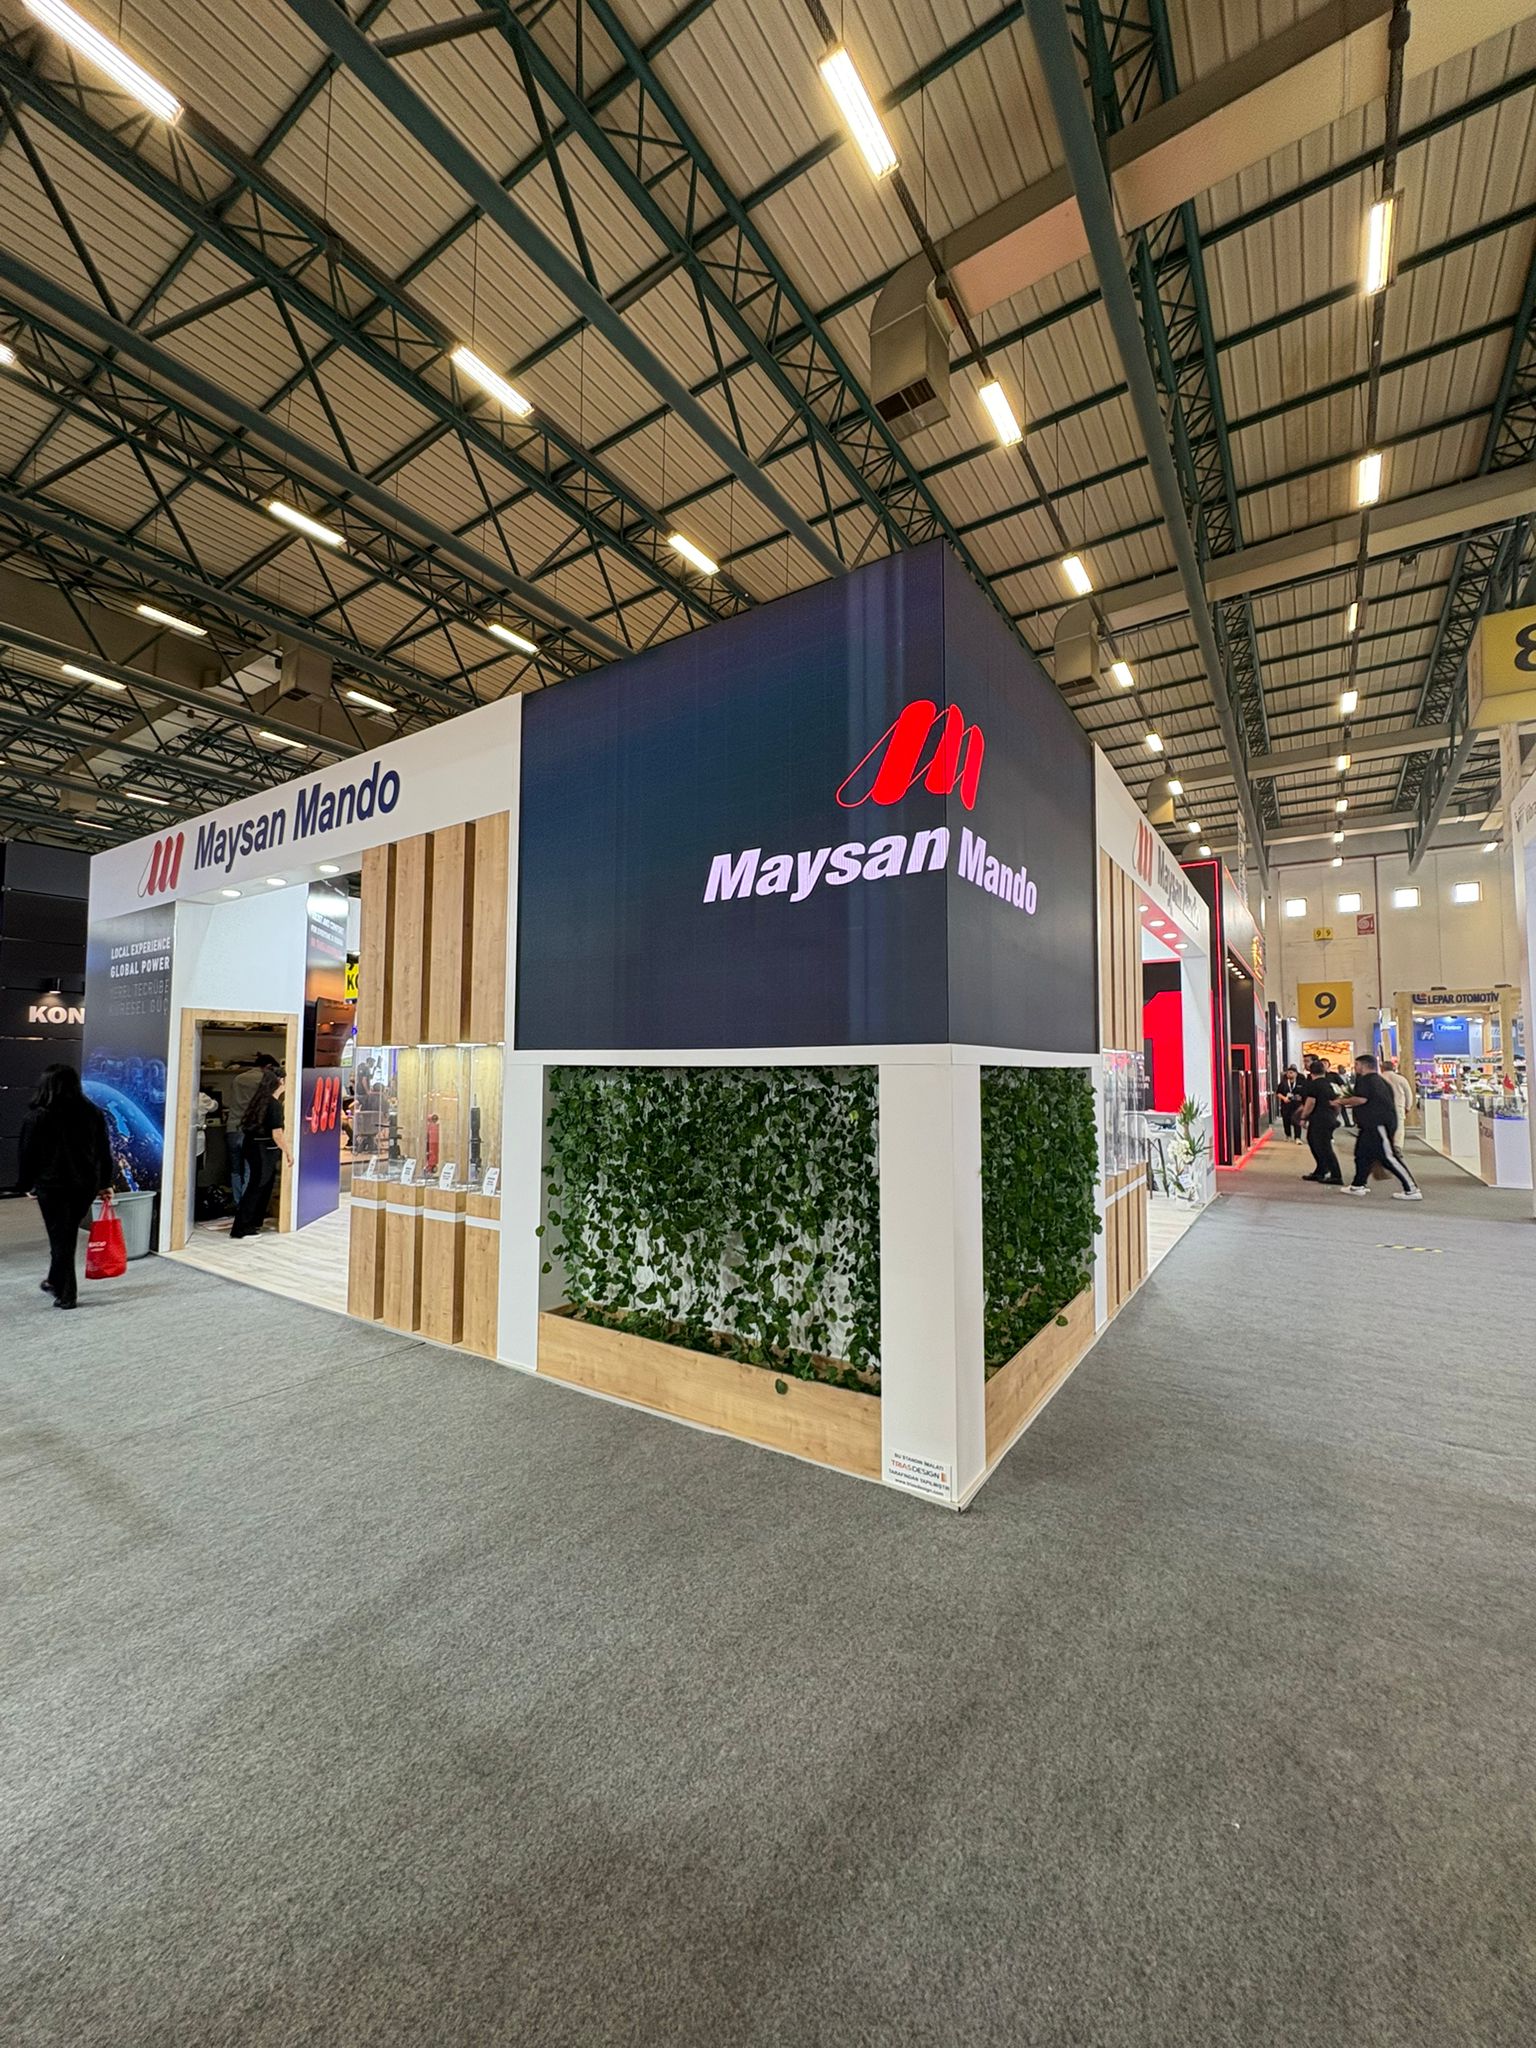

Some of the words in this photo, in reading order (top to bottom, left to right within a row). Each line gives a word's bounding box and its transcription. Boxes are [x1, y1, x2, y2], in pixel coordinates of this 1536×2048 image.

[194, 808, 287, 873] Maysan
[292, 761, 401, 841] Mando
[703, 826, 951, 903] Maysan
[957, 826, 1038, 916] Mando
[111, 946, 130, 960] LOCAL
[130, 937, 171, 956] EXPERIENCE
[111, 961, 139, 979] GLOBAL
[141, 956, 170, 973] POWER
[1314, 991, 1337, 1019] 9
[1428, 993, 1455, 1005] LEPAR
[1455, 991, 1500, 1004] OTOMOTİV
[28, 1005, 86, 1025] KON
